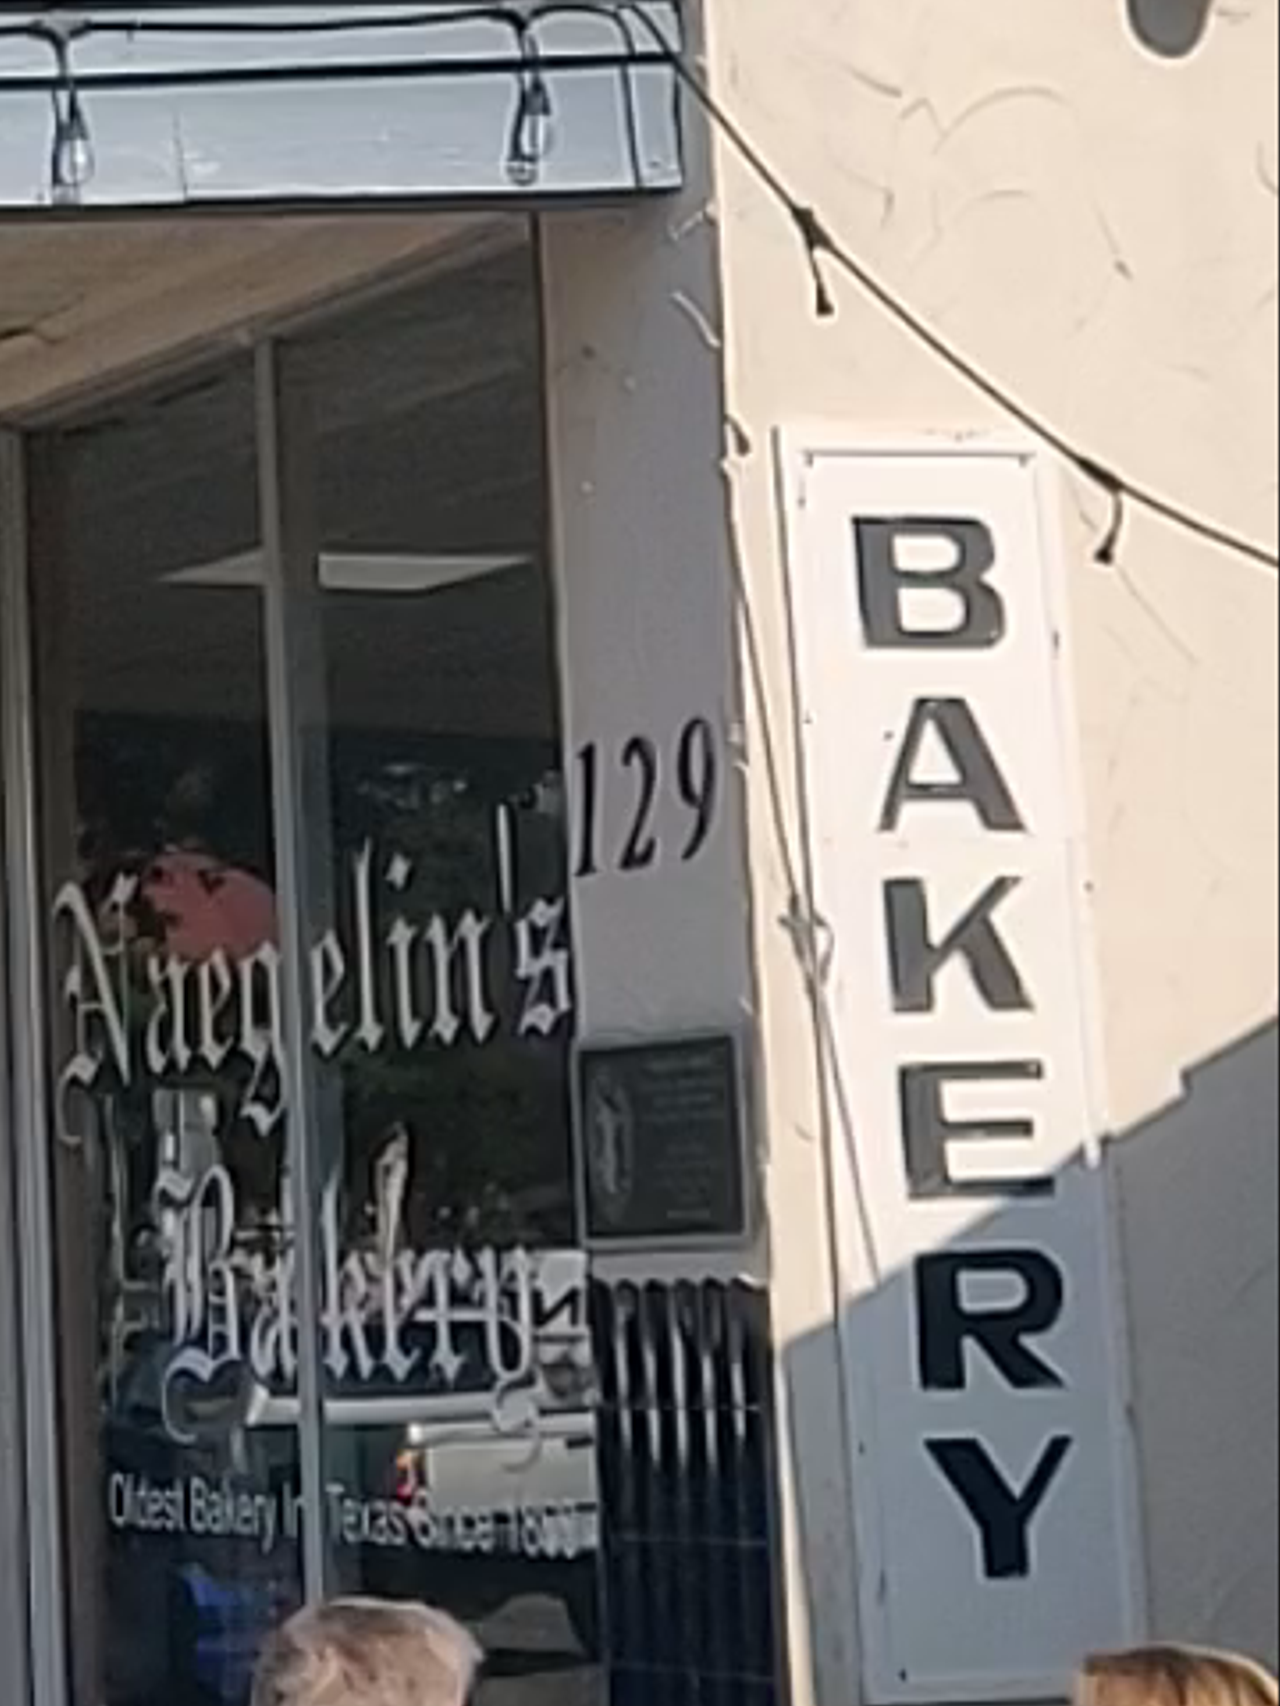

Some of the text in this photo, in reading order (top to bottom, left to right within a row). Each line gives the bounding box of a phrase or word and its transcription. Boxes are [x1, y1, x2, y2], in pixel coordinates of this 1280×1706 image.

[572, 716, 717, 878] 129
[52, 802, 575, 1150] Naegelin's
[851, 514, 1072, 1580] BAKERY
[156, 1166, 544, 1470] Bakery
[108, 1472, 186, 1530] Oldest
[189, 1476, 277, 1554] Bakery
[325, 1482, 408, 1546] Texas
